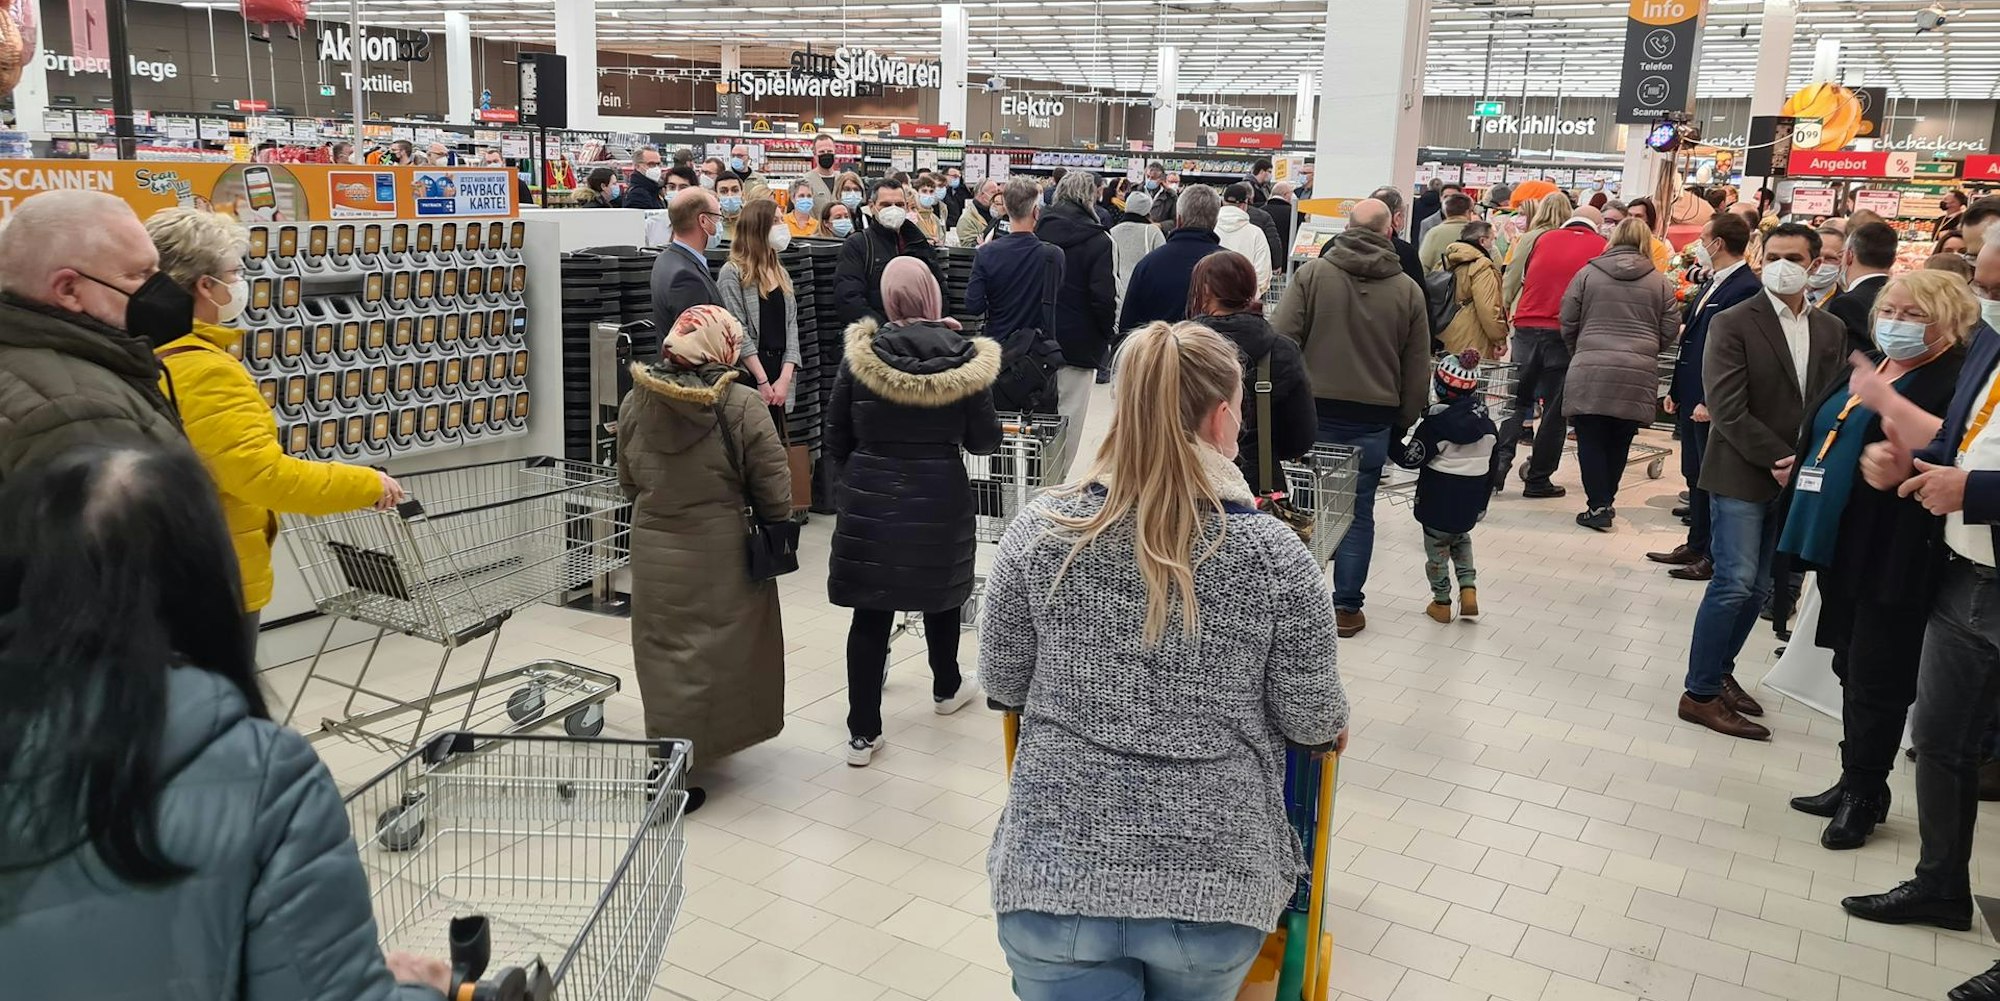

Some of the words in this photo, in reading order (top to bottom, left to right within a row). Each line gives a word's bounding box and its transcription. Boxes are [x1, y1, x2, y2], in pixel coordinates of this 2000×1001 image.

[1643, 0, 1684, 18] Info
[321, 28, 397, 61] Akion
[834, 46, 940, 88] Süßwaren
[1640, 62, 1673, 71] Telefon
[341, 71, 413, 93] Txtilien
[741, 70, 856, 101] Spielwaren
[599, 92, 622, 108] ein
[1001, 96, 1064, 116] Elektro
[1028, 113, 1050, 128] Wurst
[1199, 110, 1278, 131] Kühlregal
[1467, 114, 1596, 135] Tefkühlkost
[1239, 136, 1260, 144] Aktion
[1874, 133, 1987, 151] chebäckerei
[1810, 157, 1867, 172] Angebot
[0, 168, 114, 191] SCANNEN
[135, 168, 178, 188] Scan
[460, 183, 505, 196] PAYBACK
[470, 196, 506, 210] KARTE!
